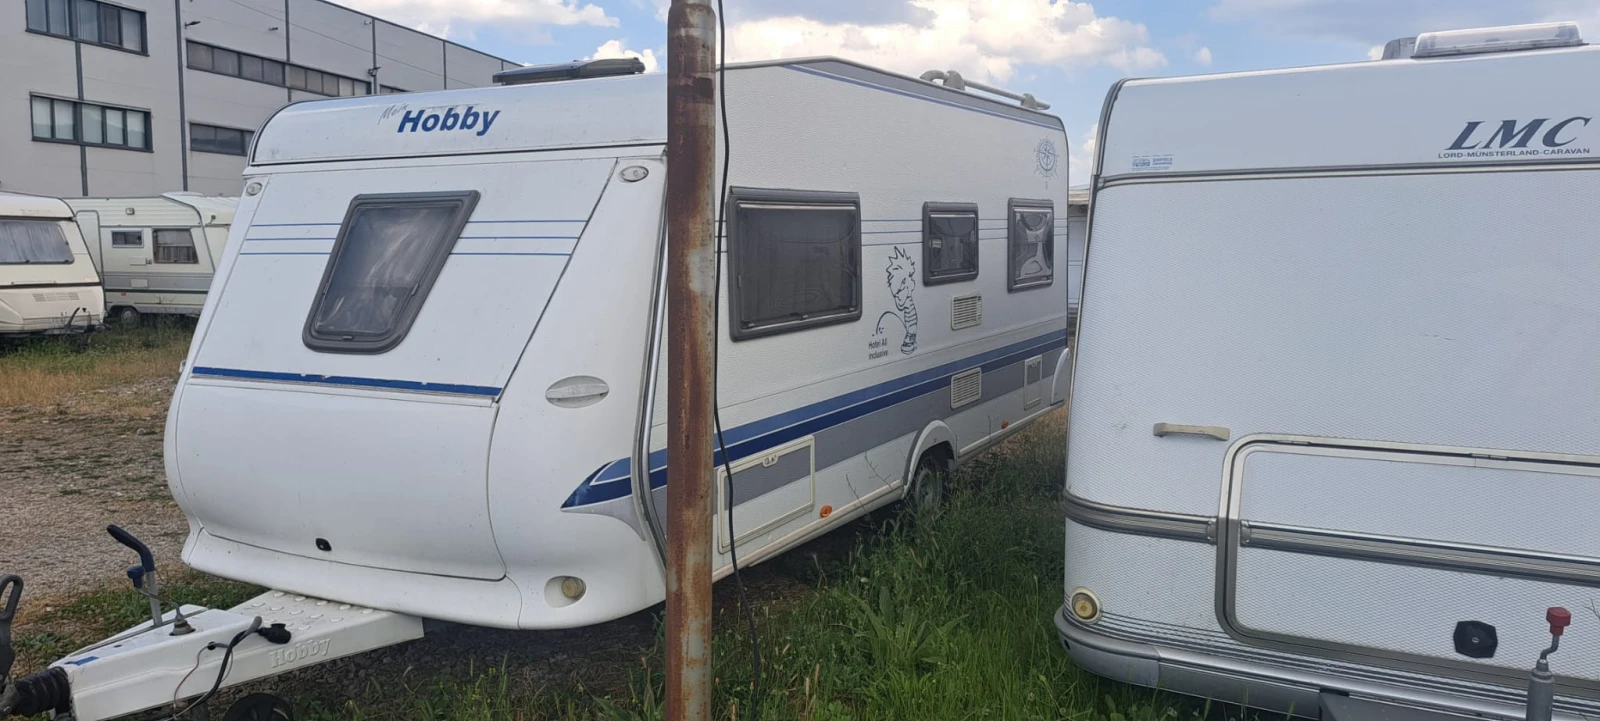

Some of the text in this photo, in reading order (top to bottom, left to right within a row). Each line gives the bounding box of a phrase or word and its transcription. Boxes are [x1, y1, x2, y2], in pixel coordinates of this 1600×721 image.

[397, 106, 501, 137] Hobby
[1444, 115, 1594, 151] LMC
[1437, 147, 1591, 160] LORD-MÜNSTERLAND-CARAVAN
[269, 637, 332, 669] Hobby
